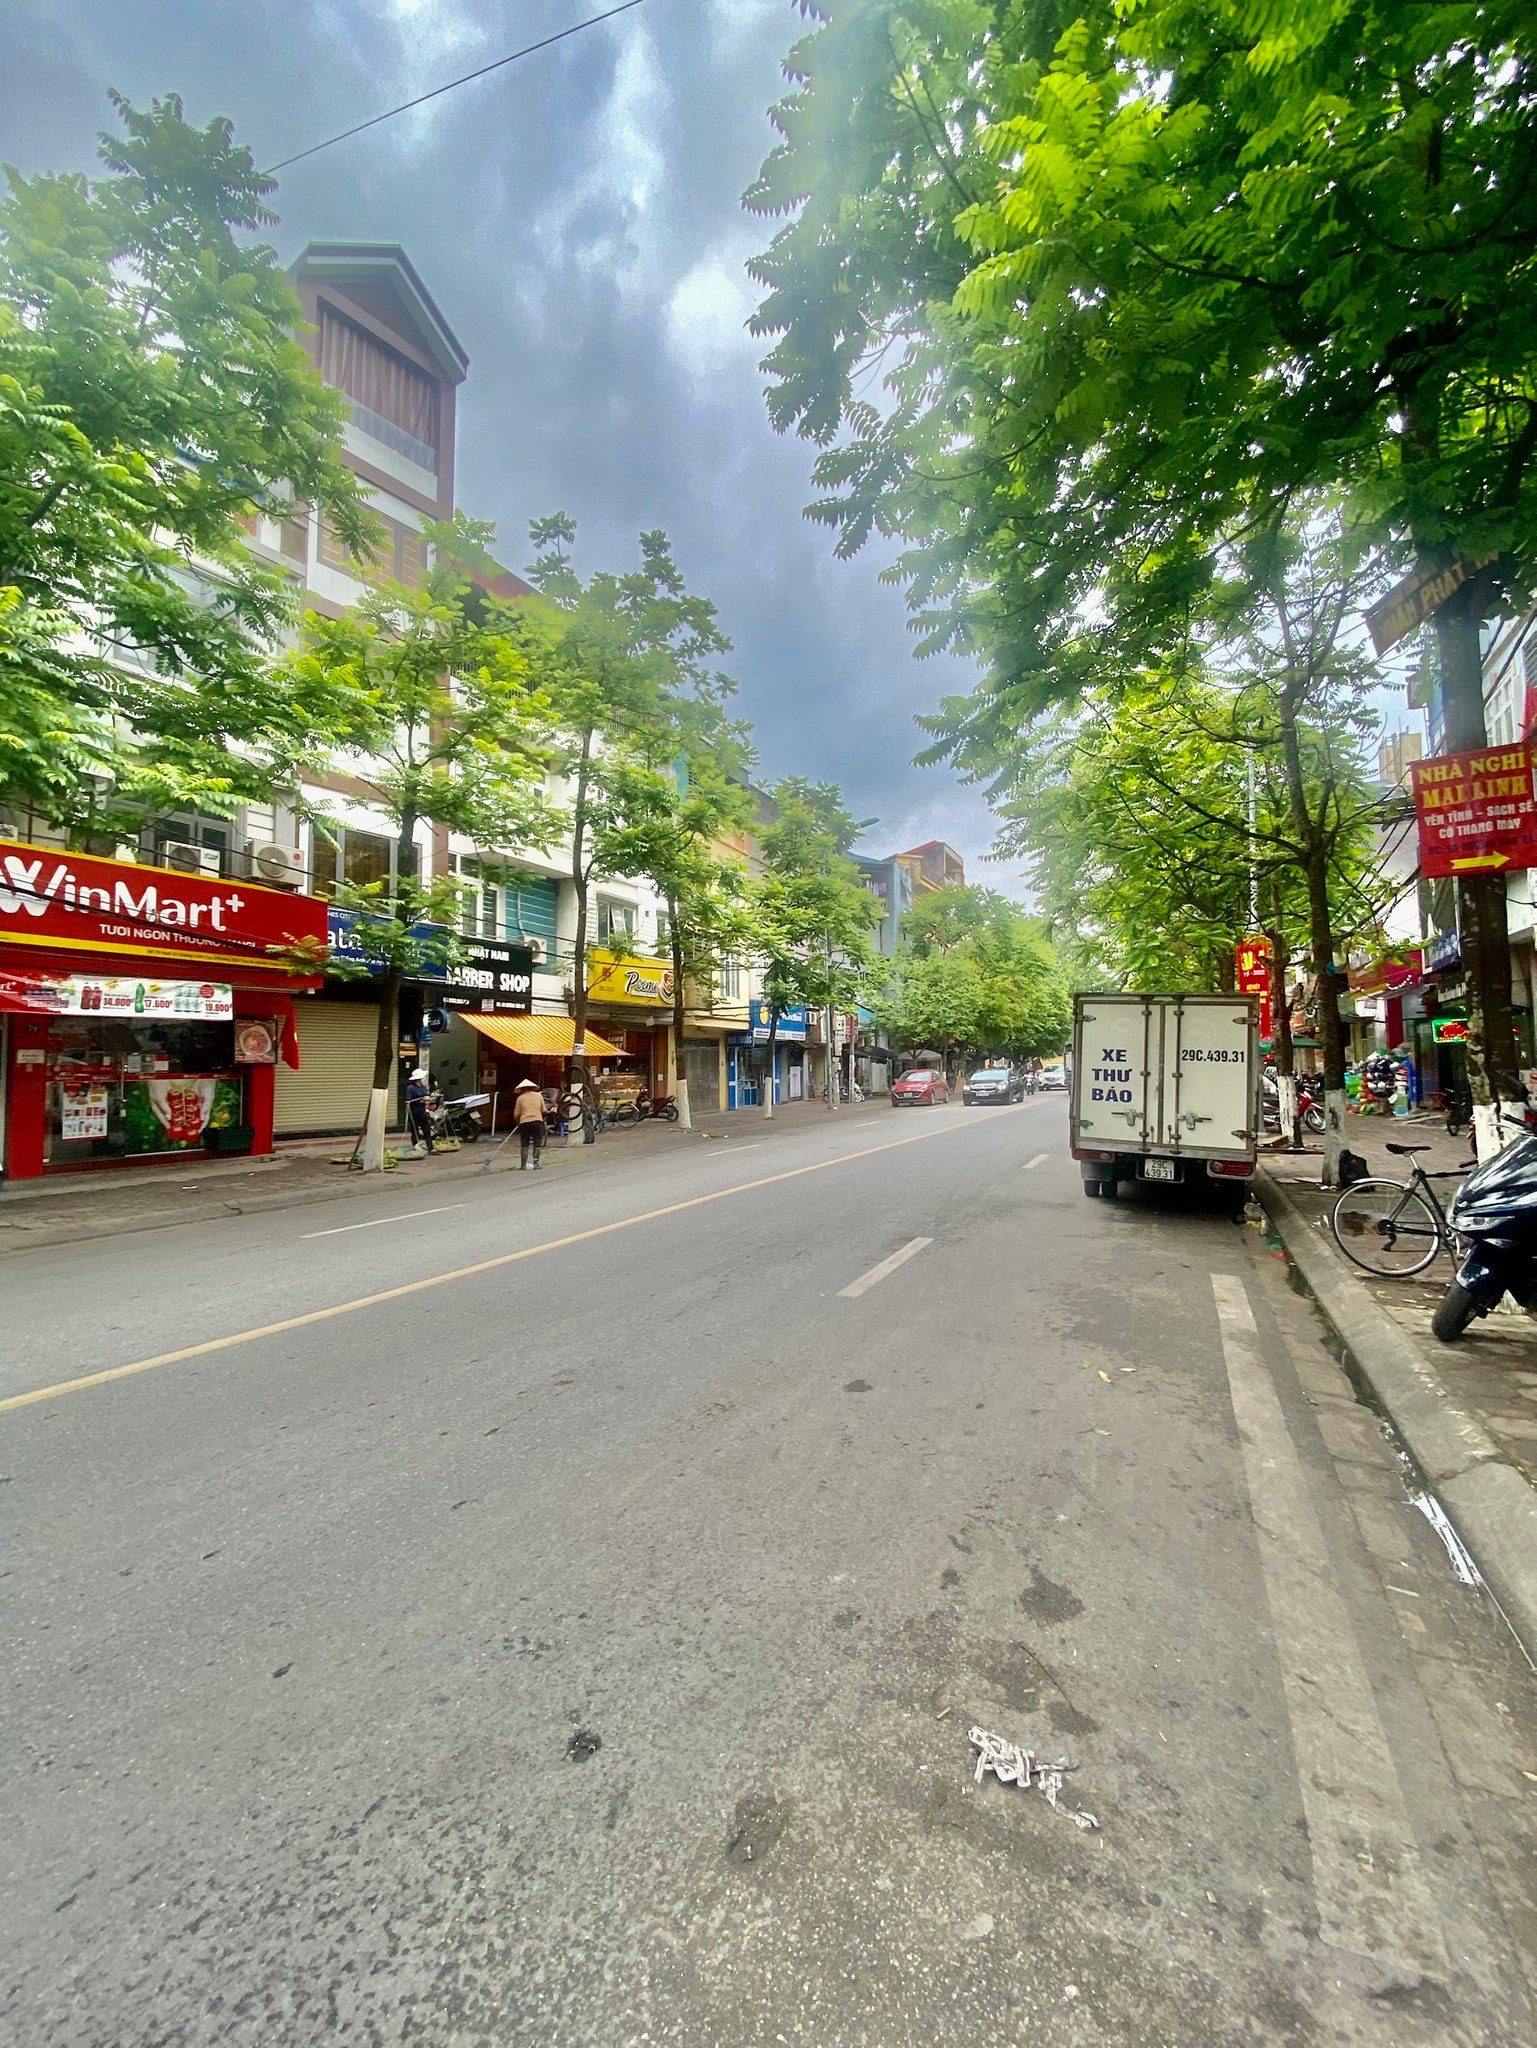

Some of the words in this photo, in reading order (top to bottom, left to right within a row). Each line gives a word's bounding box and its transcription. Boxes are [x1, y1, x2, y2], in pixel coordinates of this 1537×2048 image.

[1417, 759, 1464, 784] NHÀ
[1421, 784, 1466, 809] MAI
[1472, 775, 1528, 801] LINH
[1456, 820, 1494, 836] THANG
[133, 928, 171, 941] NGON
[499, 973, 530, 993] SHOP
[1101, 1048, 1128, 1063] XE
[1181, 1049, 1245, 1063] 29C.439.31
[1091, 1068, 1133, 1083] THƯ
[1091, 1086, 1133, 1103] BÁO
[1151, 1160, 1168, 1170] 29C
